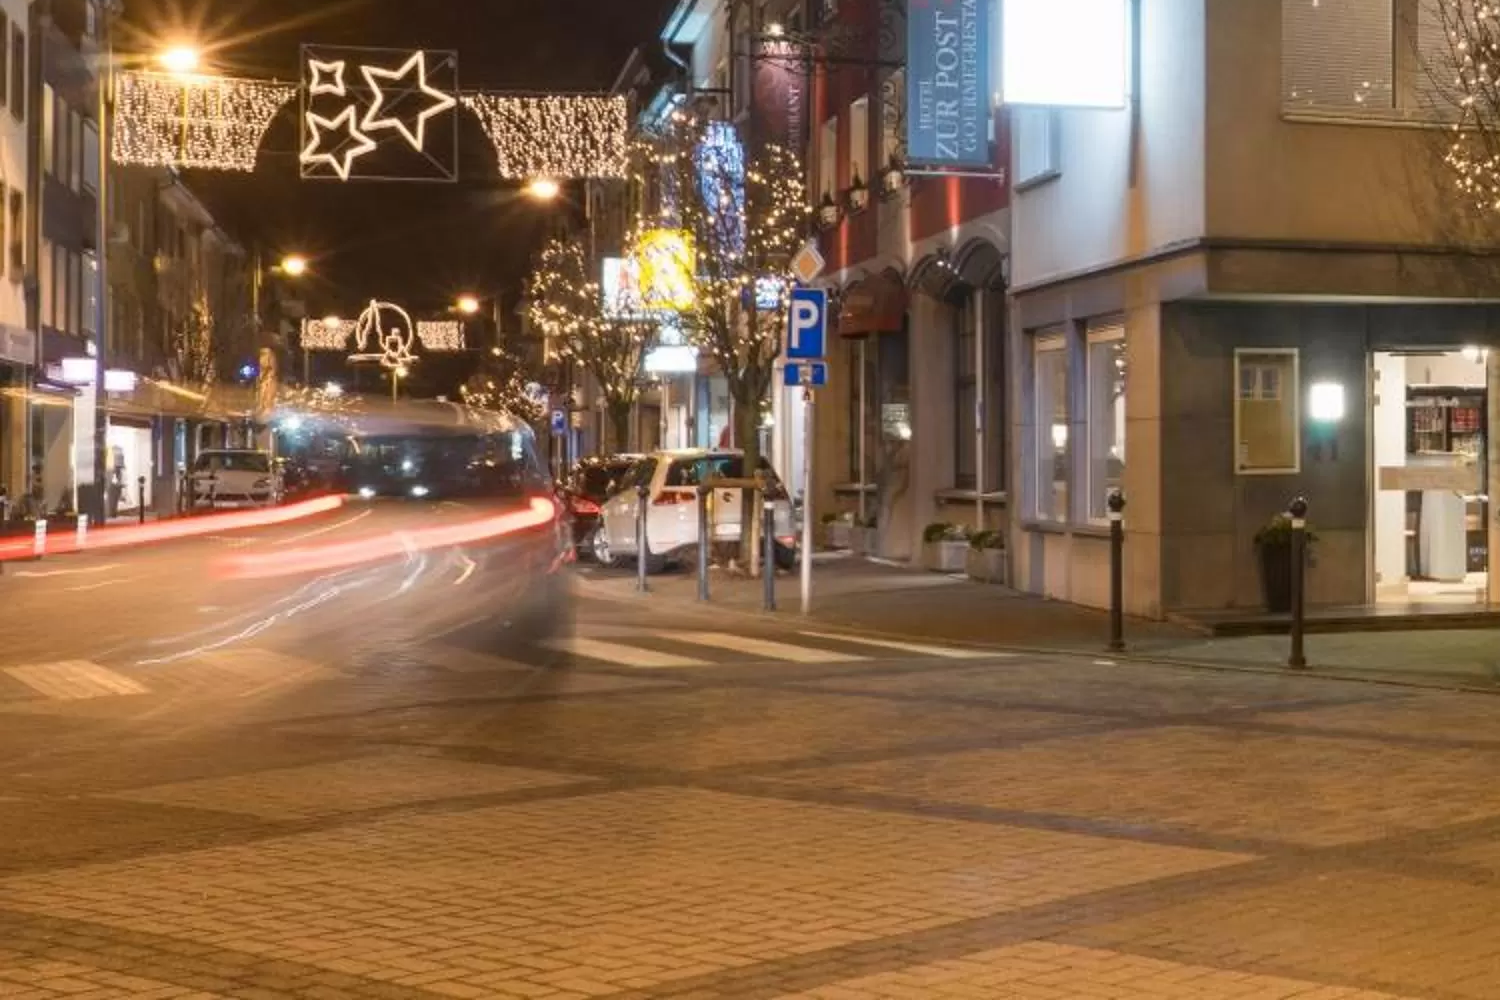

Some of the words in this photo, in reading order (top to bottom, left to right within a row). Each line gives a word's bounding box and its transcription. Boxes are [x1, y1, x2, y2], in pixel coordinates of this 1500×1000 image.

[936, 11, 959, 90] POST
[936, 100, 959, 160] ZUR
[791, 299, 819, 349] P
